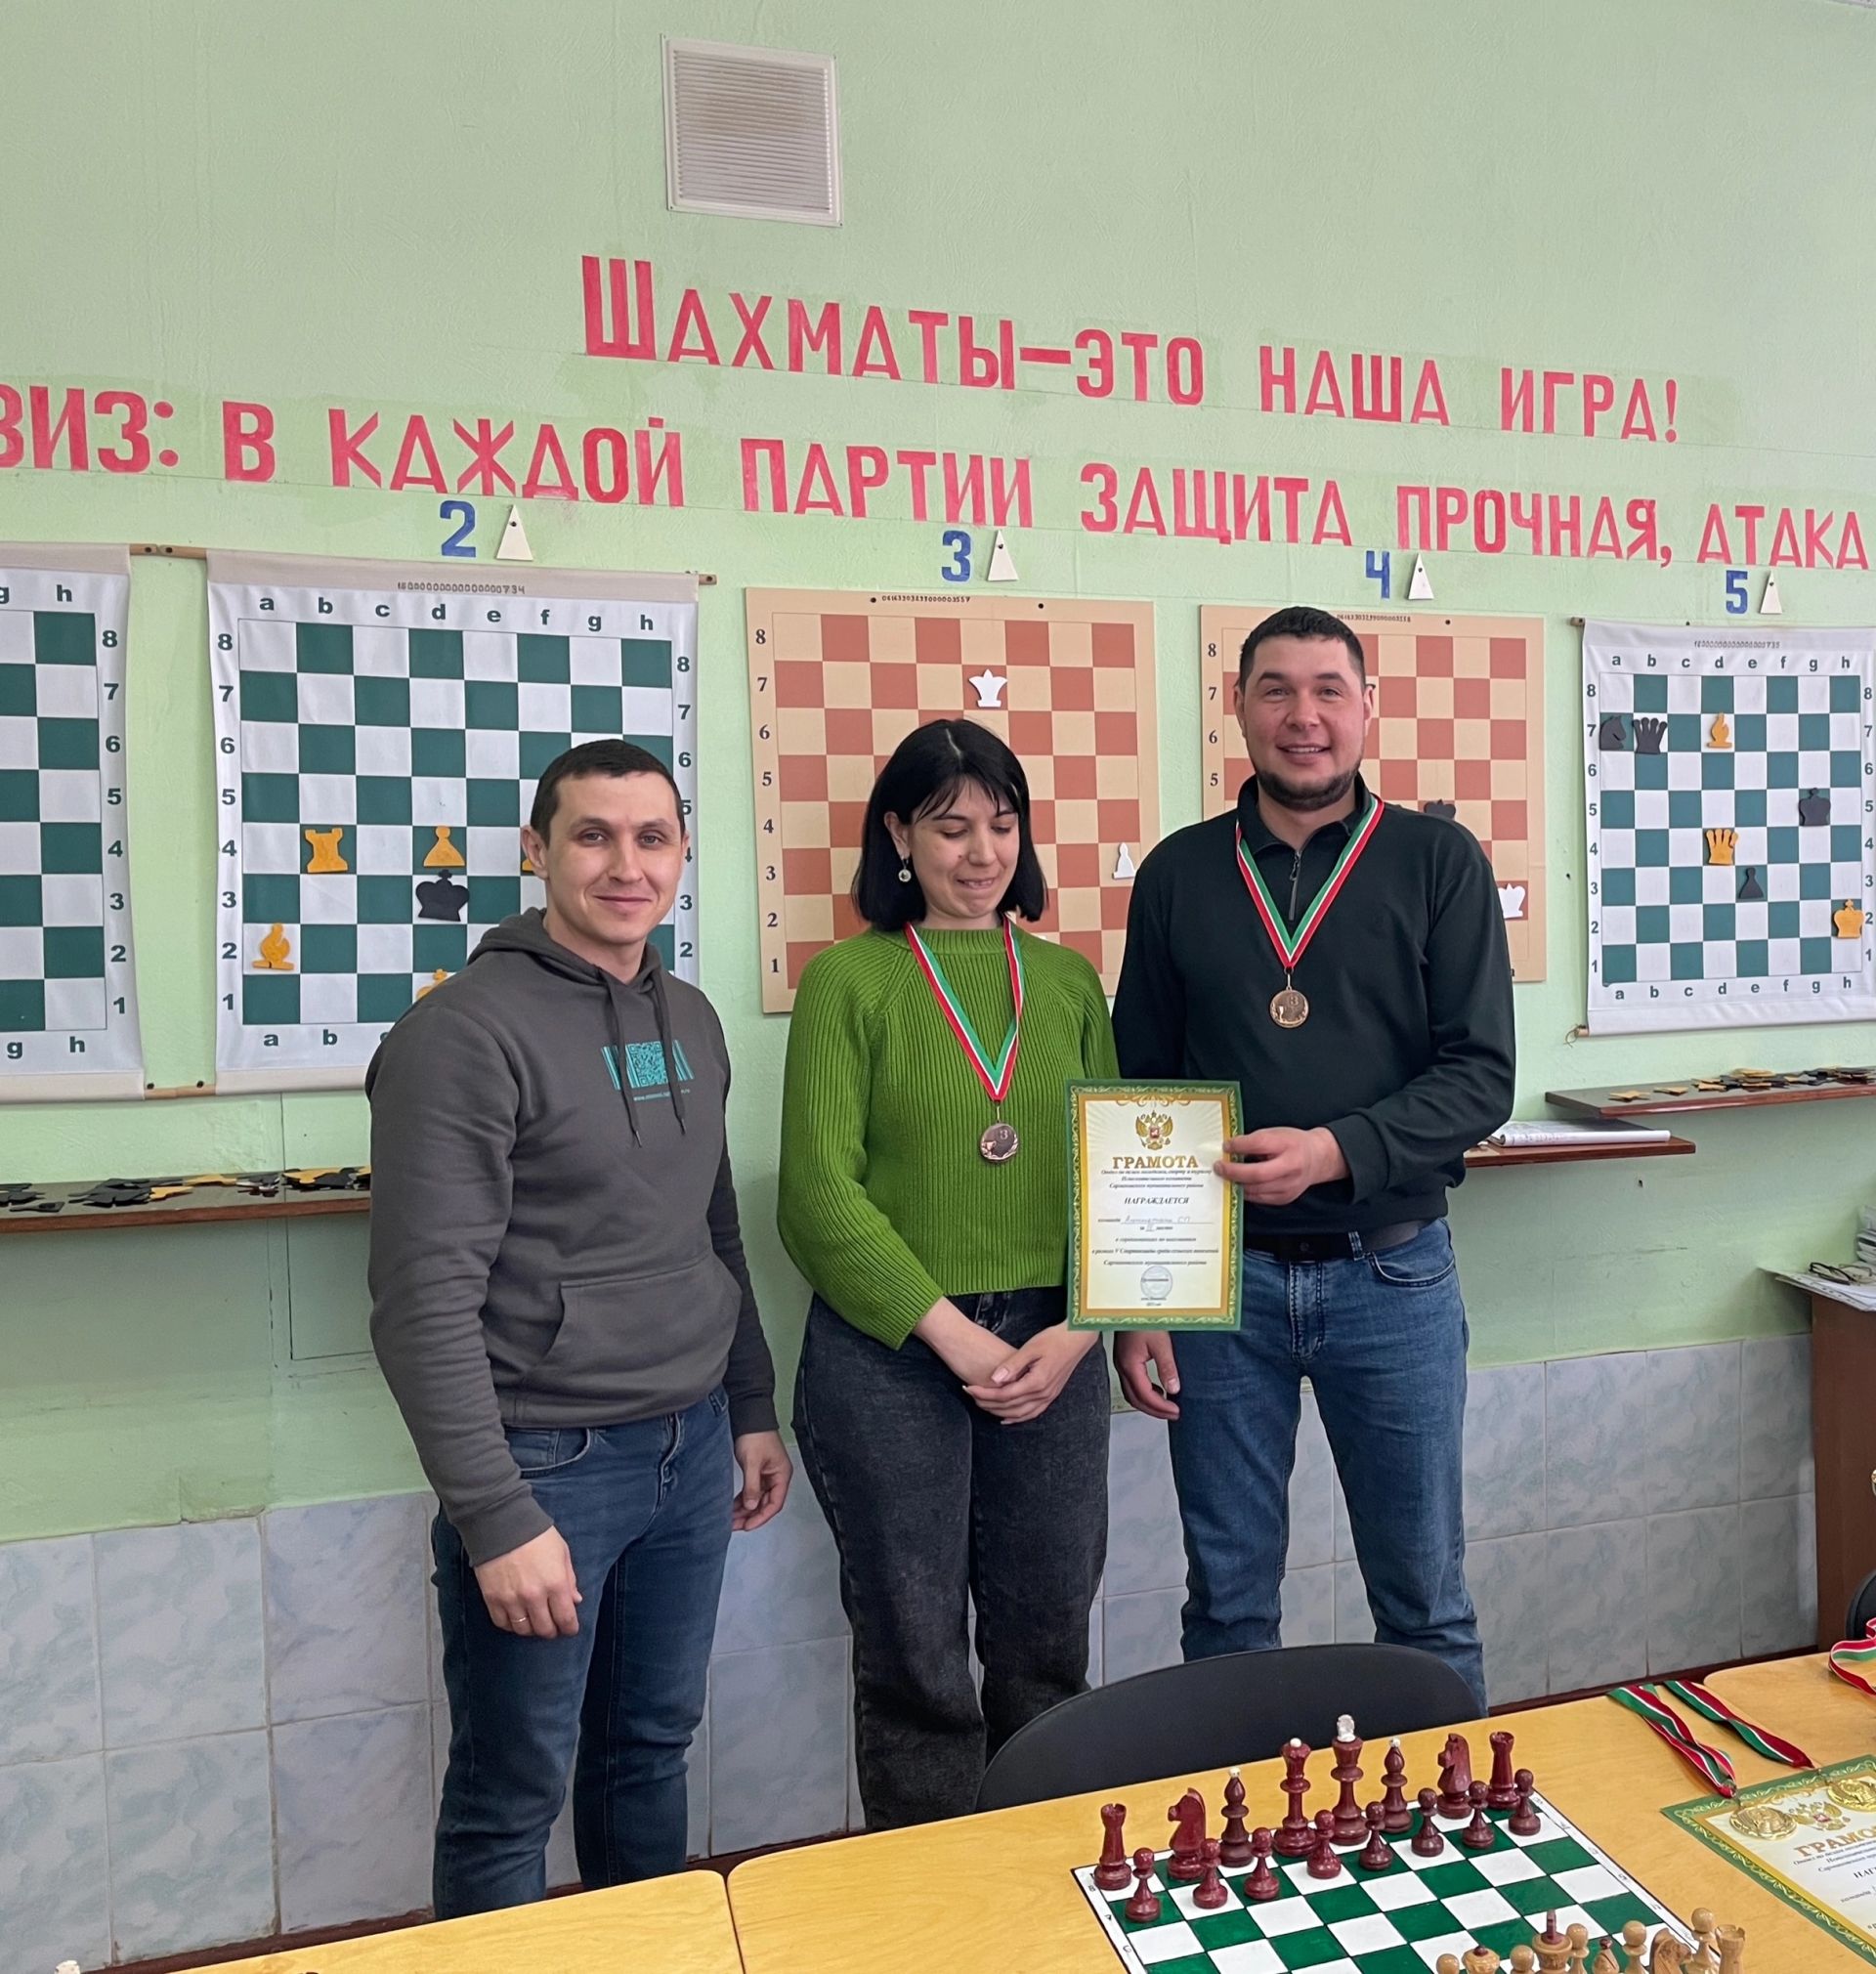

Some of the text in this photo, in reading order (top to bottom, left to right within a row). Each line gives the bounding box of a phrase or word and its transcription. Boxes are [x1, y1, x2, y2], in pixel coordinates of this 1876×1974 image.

[1261, 346, 1448, 424] НАША
[1502, 368, 1678, 442] ИГРА!
[223, 402, 275, 482] В
[328, 409, 683, 507] КАЖДОЙ
[741, 439, 1032, 527] ПАРТИИ
[1082, 464, 1351, 546] ЗАЩИТА
[1398, 487, 1673, 569] ПРОЧНАЯ,
[1698, 506, 1868, 568] АТАКА
[440, 500, 476, 557] 2
[942, 531, 971, 581] 3
[1365, 550, 1390, 598] 4
[57, 584, 72, 602] h
[1726, 570, 1748, 614] 5
[260, 597, 653, 631] a b c d e f g h
[677, 657, 690, 672] 8
[1611, 653, 1851, 672] a b c d e f g h
[678, 705, 691, 719] 7
[1208, 642, 1218, 787] 8 7 6 5
[679, 751, 691, 767] 6
[755, 628, 780, 973] 8 7 6 5 4 3 2 1
[103, 630, 126, 1013] 8 7 6 5 4 3 2 1
[218, 633, 236, 1009] 8 7 6 5 4 3 2 1
[1586, 683, 1599, 973] 8 7 6 5 4 3 2 1
[1863, 686, 1875, 963] 8 7 6 5 4 3 2 1
[680, 895, 692, 910] 3
[680, 942, 693, 957] 2
[1614, 975, 1852, 1001] a b c d e f g h
[7, 1036, 85, 1059] g h
[264, 1029, 337, 1046] a b
[1112, 1155, 1199, 1169] ГРАМОТА
